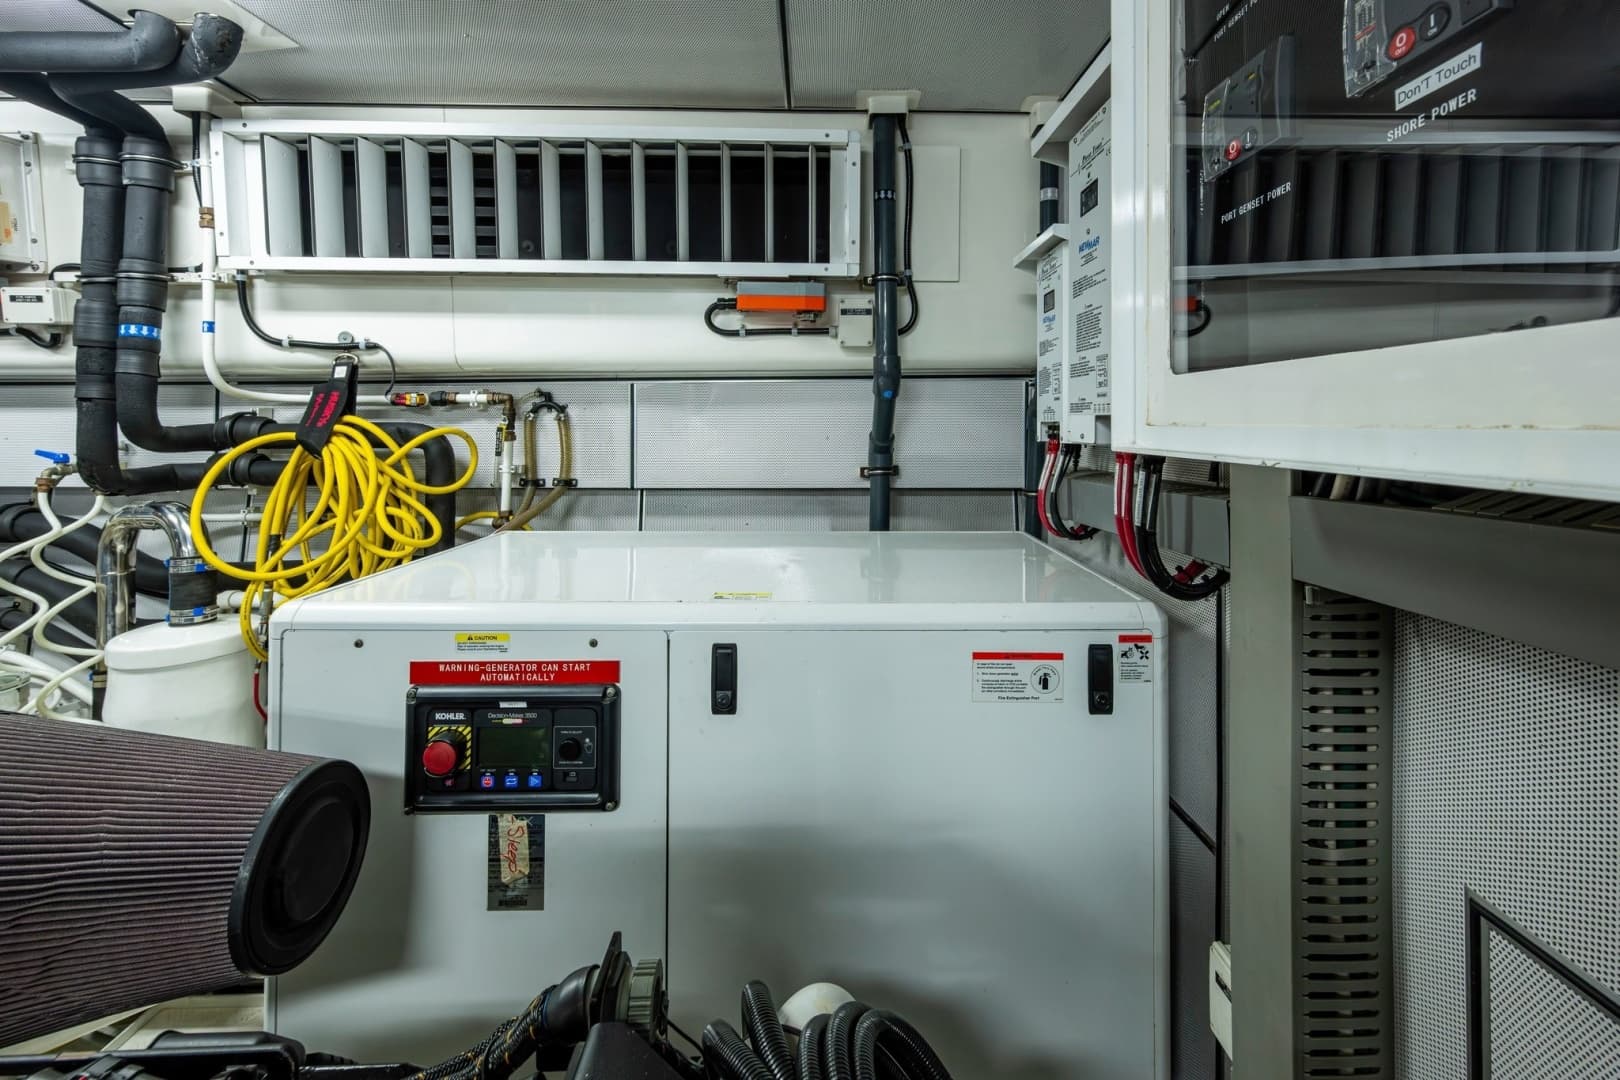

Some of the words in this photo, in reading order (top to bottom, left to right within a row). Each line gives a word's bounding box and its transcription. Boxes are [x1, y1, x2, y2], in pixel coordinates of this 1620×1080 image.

[1397, 76, 1433, 104] Don'T
[1436, 54, 1477, 82] Touch
[1387, 114, 1426, 142] SHORE
[1431, 88, 1477, 121] POWER
[1221, 208, 1236, 224] PORT
[1238, 194, 1264, 215] GENSET
[1267, 181, 1291, 202] POWER
[439, 663, 537, 672] WARNING-GENERATOR
[541, 663, 559, 672] CAN
[562, 663, 591, 672] START
[480, 673, 555, 681] AUTOMATICALLY
[435, 712, 465, 720] KOHLER
